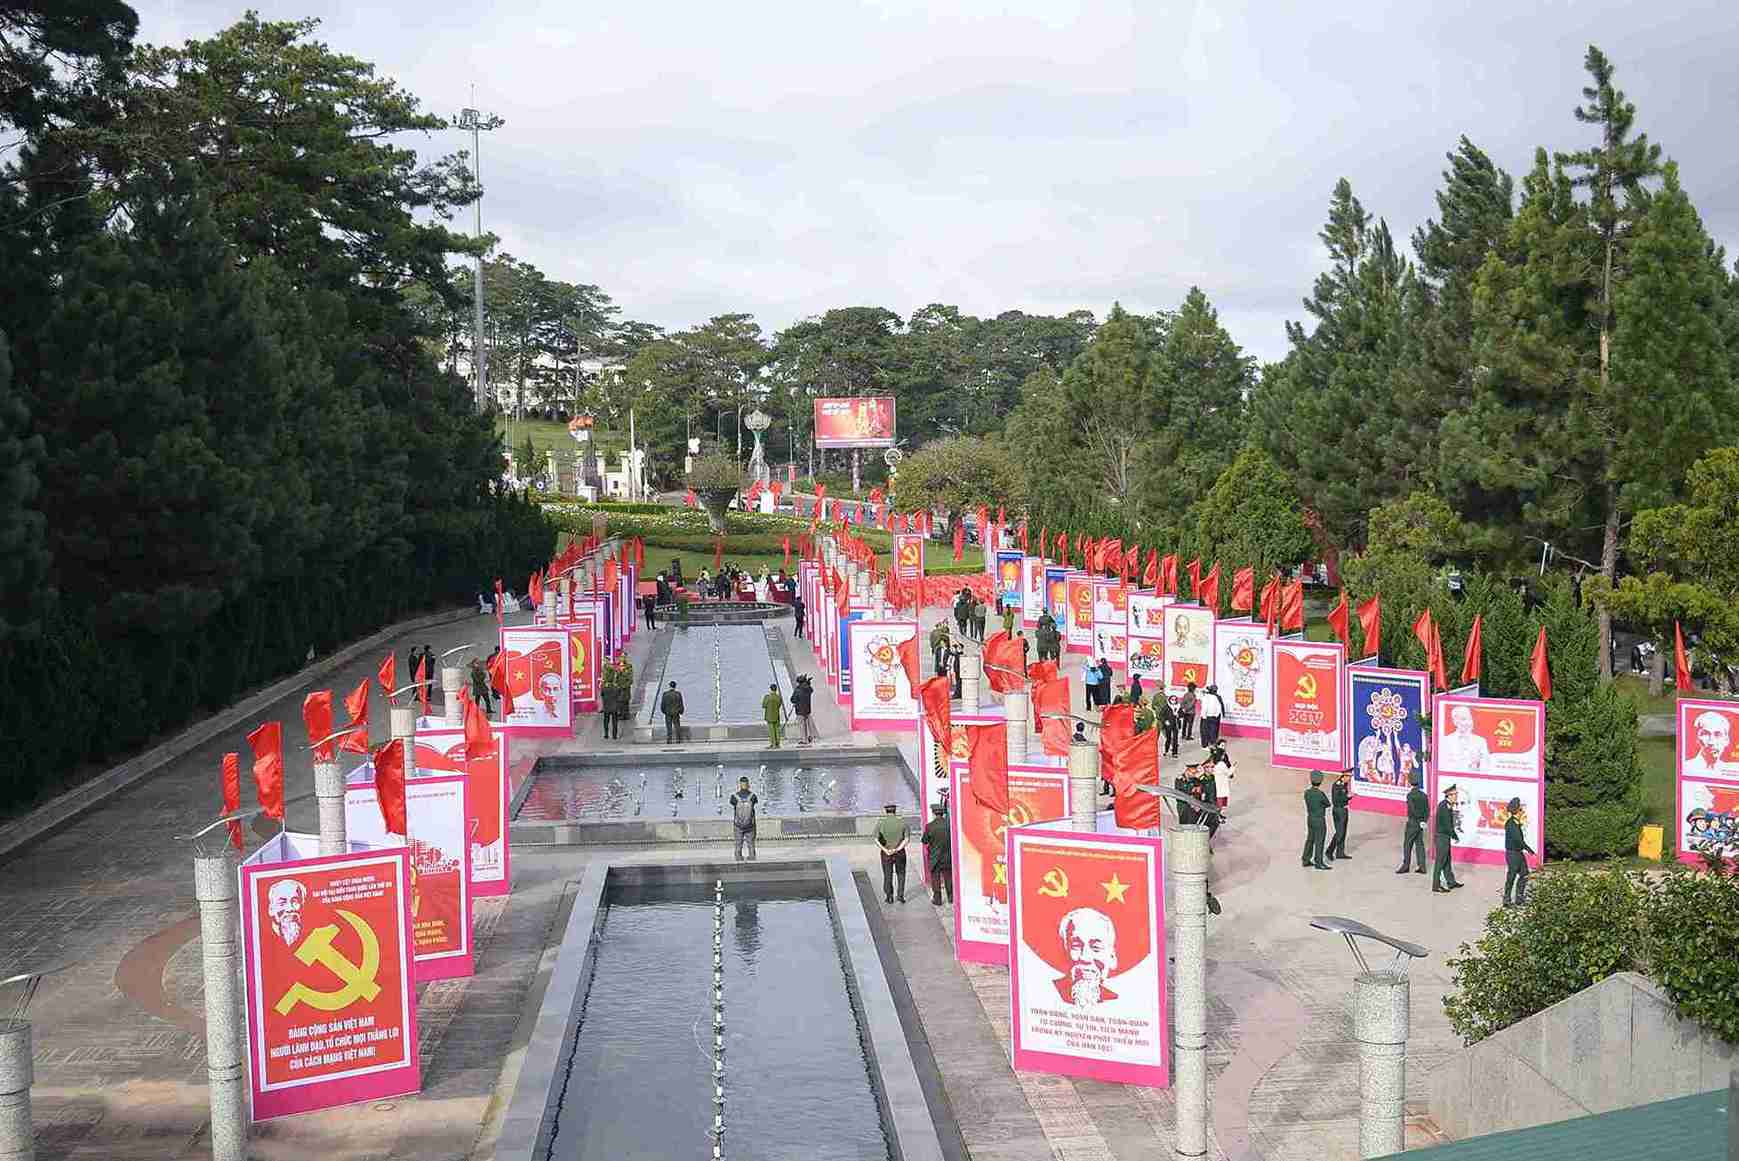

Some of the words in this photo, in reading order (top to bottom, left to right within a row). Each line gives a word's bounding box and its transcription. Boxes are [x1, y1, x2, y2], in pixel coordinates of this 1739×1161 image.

[309, 1022, 328, 1036] CỘNG
[328, 1018, 342, 1032] SẢN
[343, 1018, 358, 1031] VIỆT
[335, 1034, 352, 1048] CHỨC
[304, 1054, 322, 1068] CÁCH
[324, 1052, 343, 1065] MẠNG
[344, 1048, 358, 1063] VIỆT
